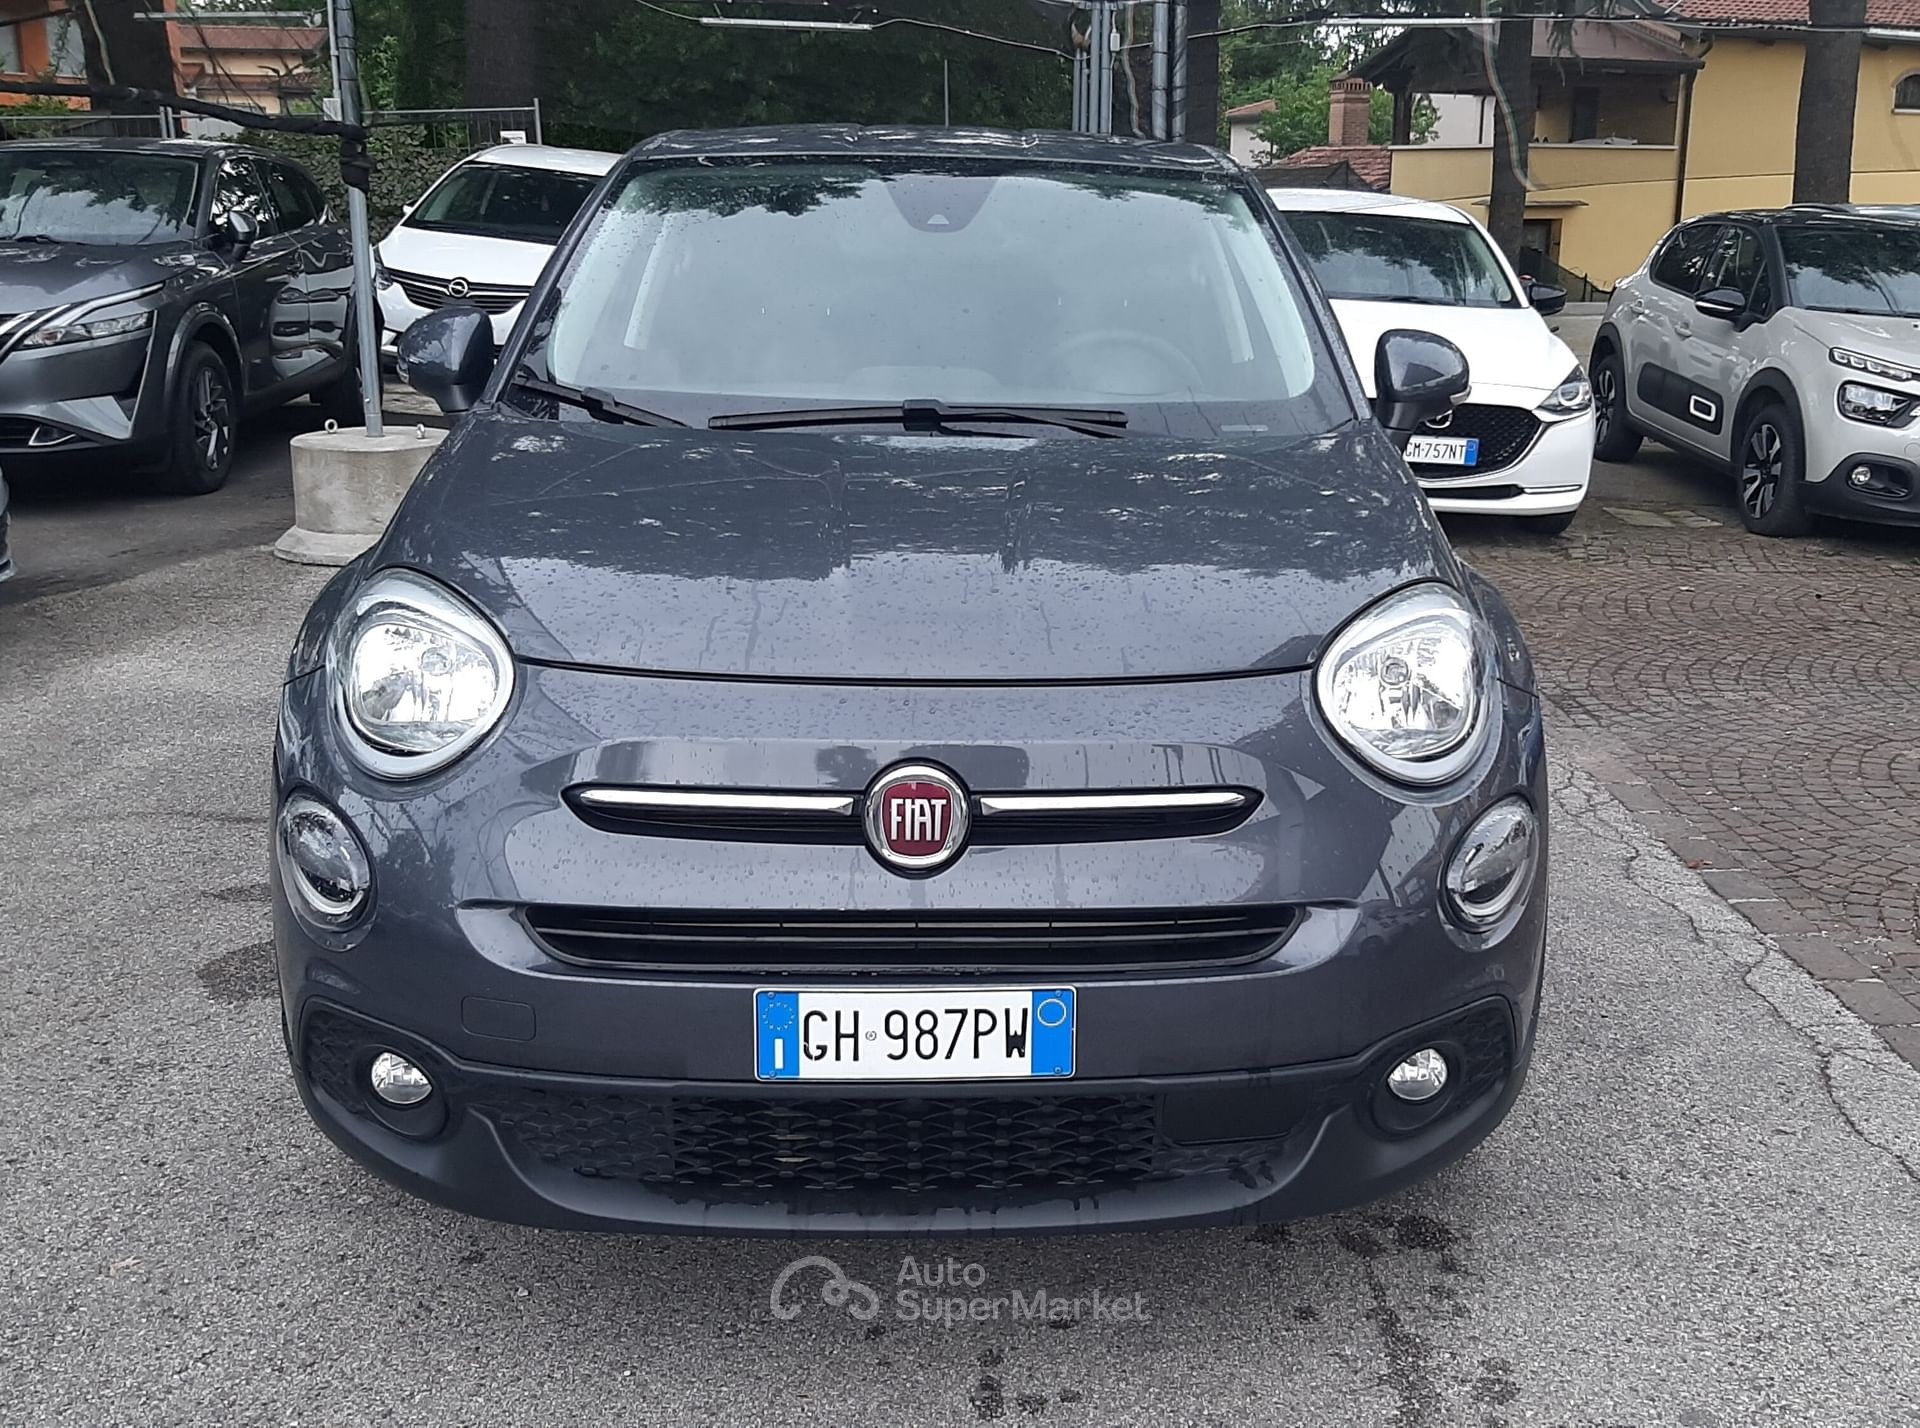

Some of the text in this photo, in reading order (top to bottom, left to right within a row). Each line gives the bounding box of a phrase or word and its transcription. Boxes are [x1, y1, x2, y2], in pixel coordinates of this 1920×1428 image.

[1424, 443, 1466, 459] 757NT
[890, 798, 947, 841] FIAT
[803, 1007, 1028, 1062] GH 987PW
